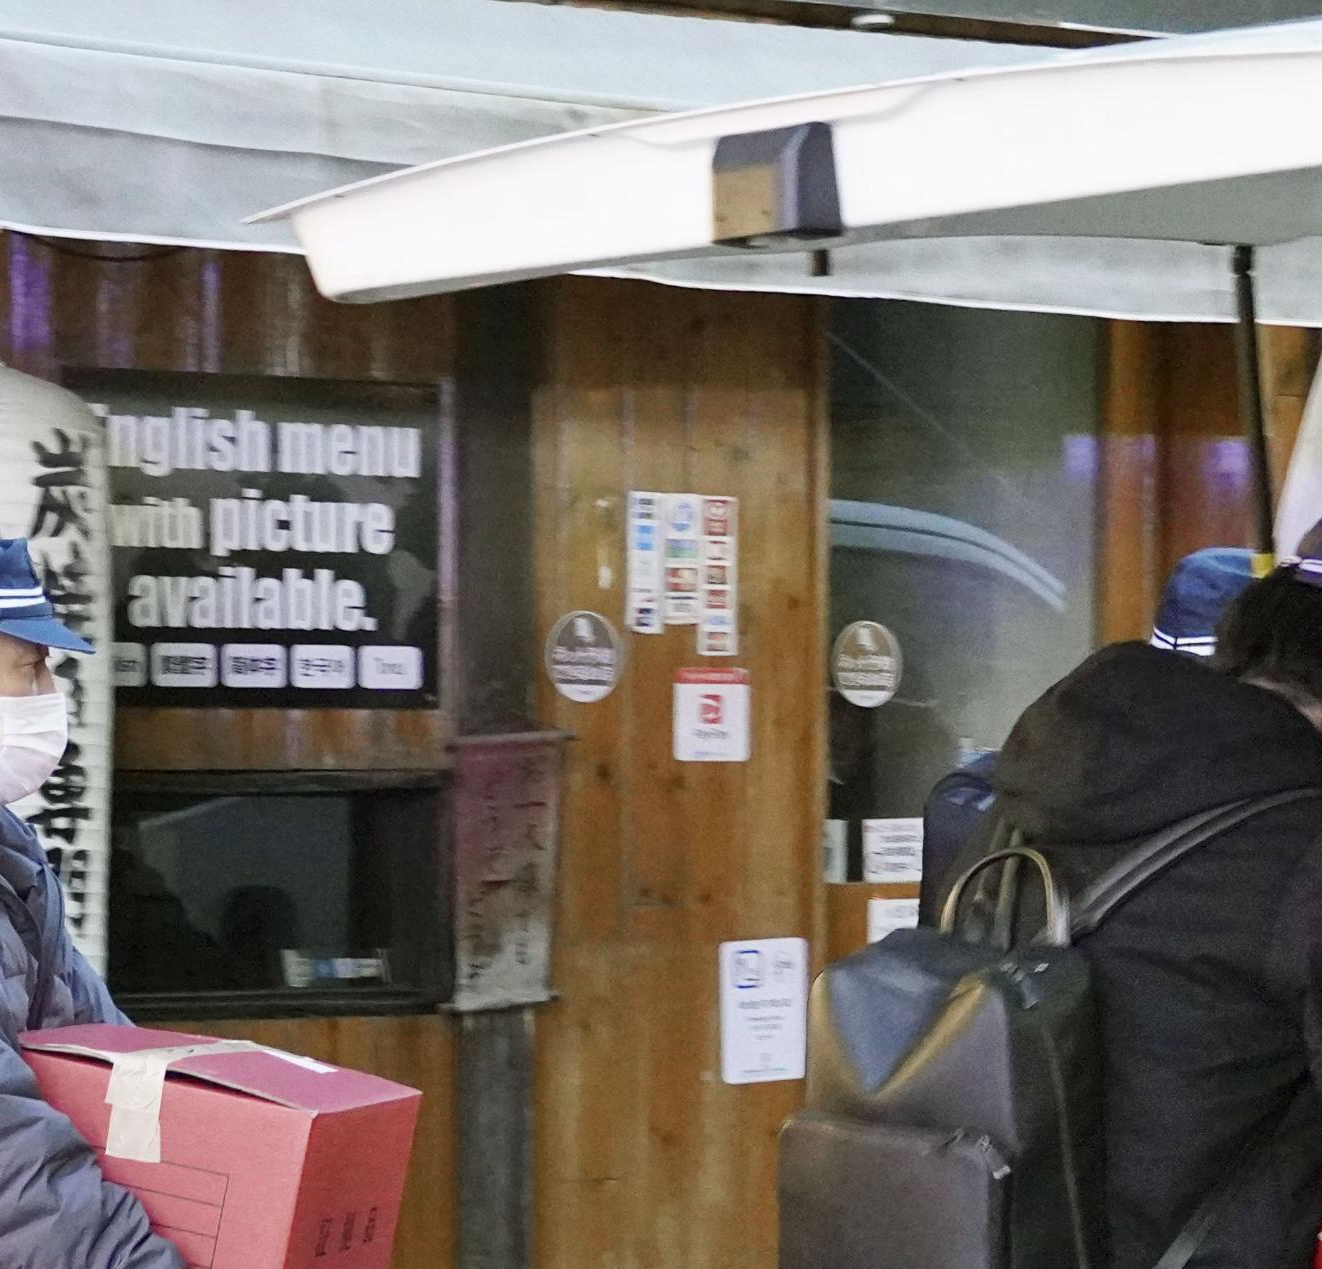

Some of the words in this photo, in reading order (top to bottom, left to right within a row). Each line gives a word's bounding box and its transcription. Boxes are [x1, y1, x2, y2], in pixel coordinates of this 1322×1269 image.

[86, 401, 272, 477] nglish
[279, 421, 422, 479] menu
[210, 489, 395, 556] picture
[128, 567, 377, 632] available.
